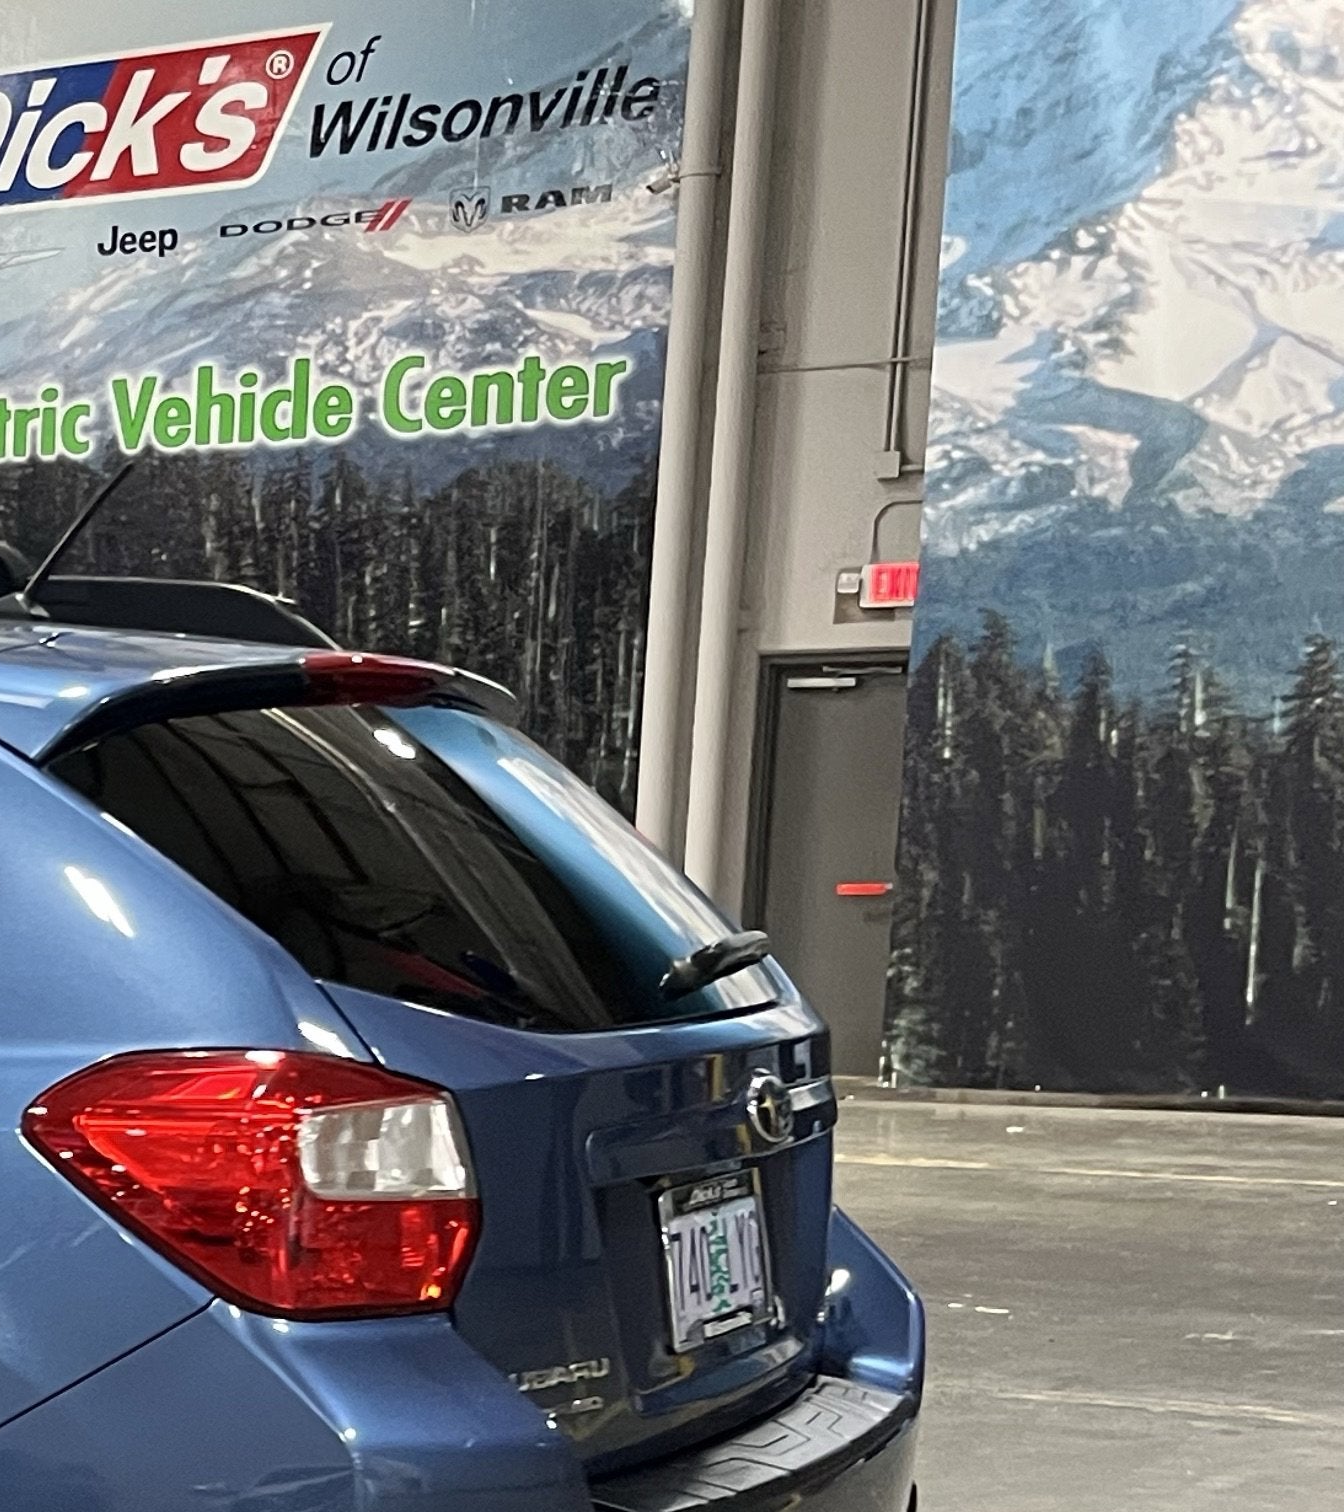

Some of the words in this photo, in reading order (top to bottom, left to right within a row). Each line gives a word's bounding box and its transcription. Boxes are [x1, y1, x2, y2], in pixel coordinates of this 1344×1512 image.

[325, 34, 382, 87] of
[309, 64, 661, 159] Wilsonville
[500, 184, 613, 214] RAM
[219, 208, 382, 239] DODGE
[97, 225, 179, 258] Jeep
[111, 358, 353, 450] Vehicle
[383, 355, 627, 434] Center
[508, 1357, 610, 1391] UBARU
